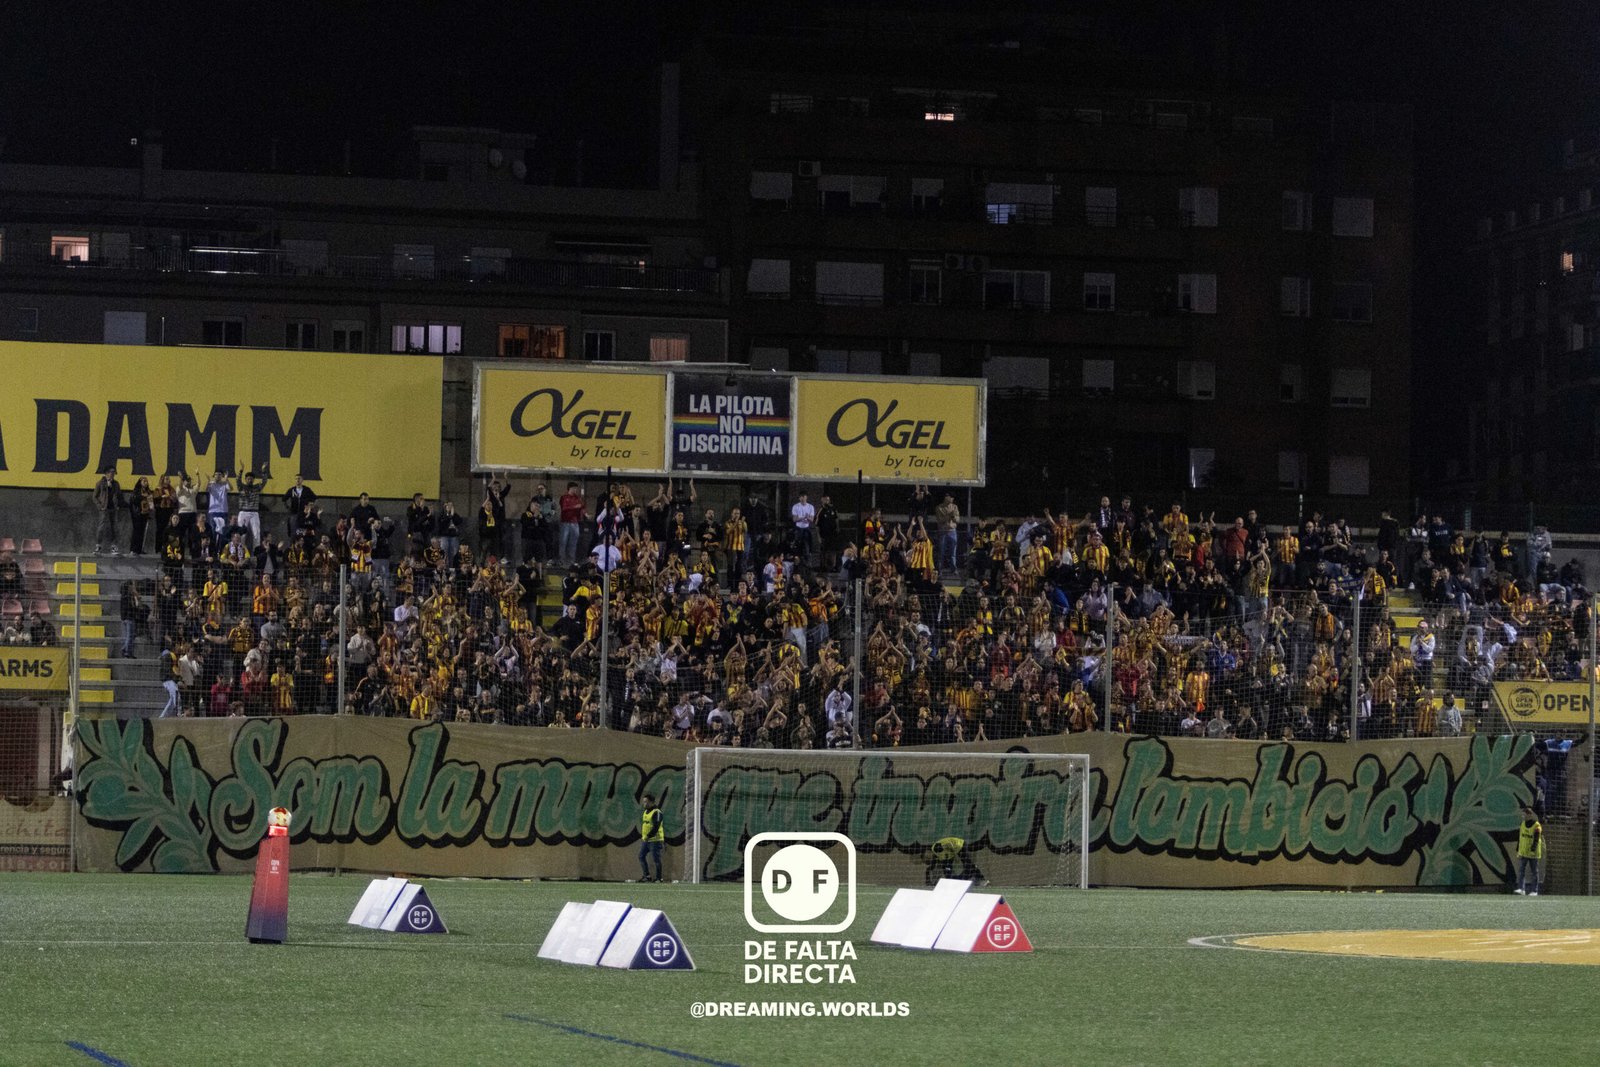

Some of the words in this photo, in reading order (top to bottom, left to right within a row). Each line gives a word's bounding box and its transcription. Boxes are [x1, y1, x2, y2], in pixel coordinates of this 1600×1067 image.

[689, 394, 711, 413] LA
[715, 395, 774, 415] PILOTA
[719, 415, 744, 435] NO
[32, 398, 325, 481] DAMM
[679, 433, 783, 455] DISCRIMINA
[570, 445, 589, 460] by
[594, 445, 632, 459] Taica
[884, 455, 904, 469] by
[908, 455, 946, 468] Taica
[1544, 694, 1591, 712] OPEN
[210, 717, 393, 855] Som
[396, 720, 487, 847] la
[483, 757, 692, 847] musa
[702, 764, 845, 881] que
